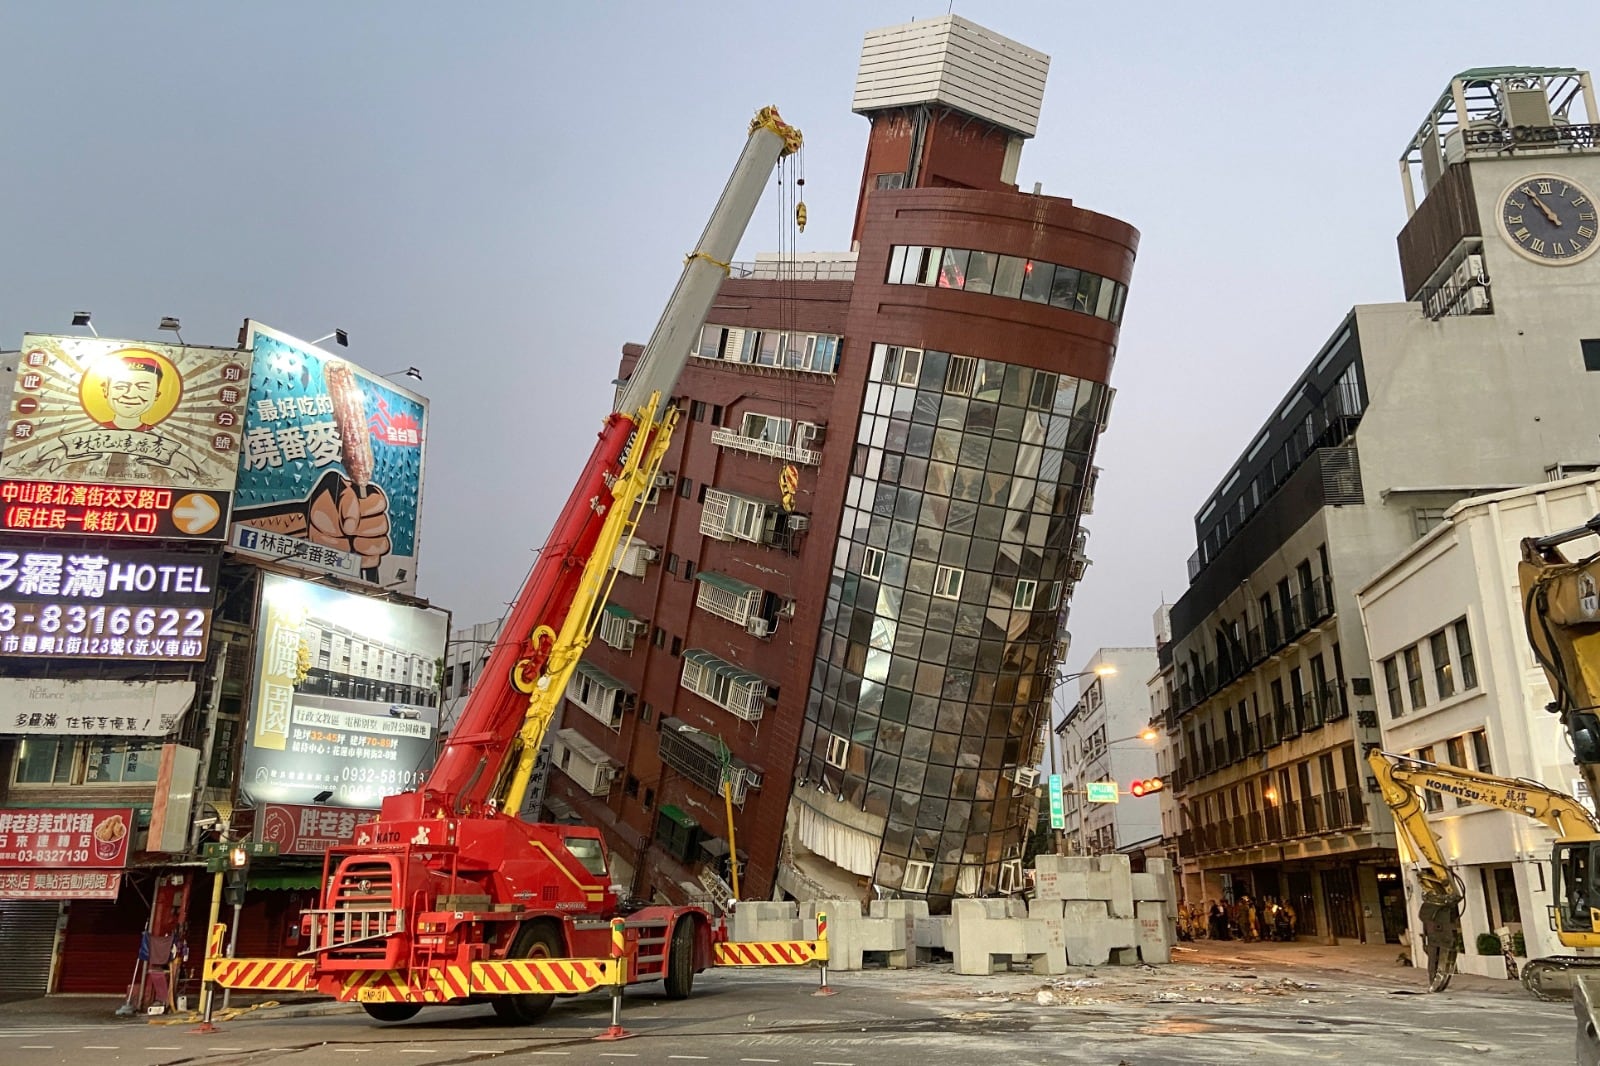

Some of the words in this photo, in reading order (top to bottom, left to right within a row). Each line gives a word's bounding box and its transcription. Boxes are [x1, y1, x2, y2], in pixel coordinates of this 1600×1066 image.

[213, 367, 240, 450] 別無分號
[257, 394, 334, 422] 最好吃的
[242, 420, 344, 471] 燒番麥
[2, 483, 172, 510] 中山路北濱街交叉路口
[7, 507, 158, 533] (原住民一條街入口)
[260, 532, 340, 568] 林記燒番麥
[0, 552, 109, 598] 多羅滿
[109, 563, 211, 594] HOTEL
[0, 603, 206, 637] 3-8316622
[15, 712, 58, 727] 多羅滿
[1425, 779, 1480, 800] KOMATSU
[0, 813, 95, 834] 胖老爹美式炸雞
[377, 832, 400, 842] KATO
[18, 850, 89, 863] 03-8327130
